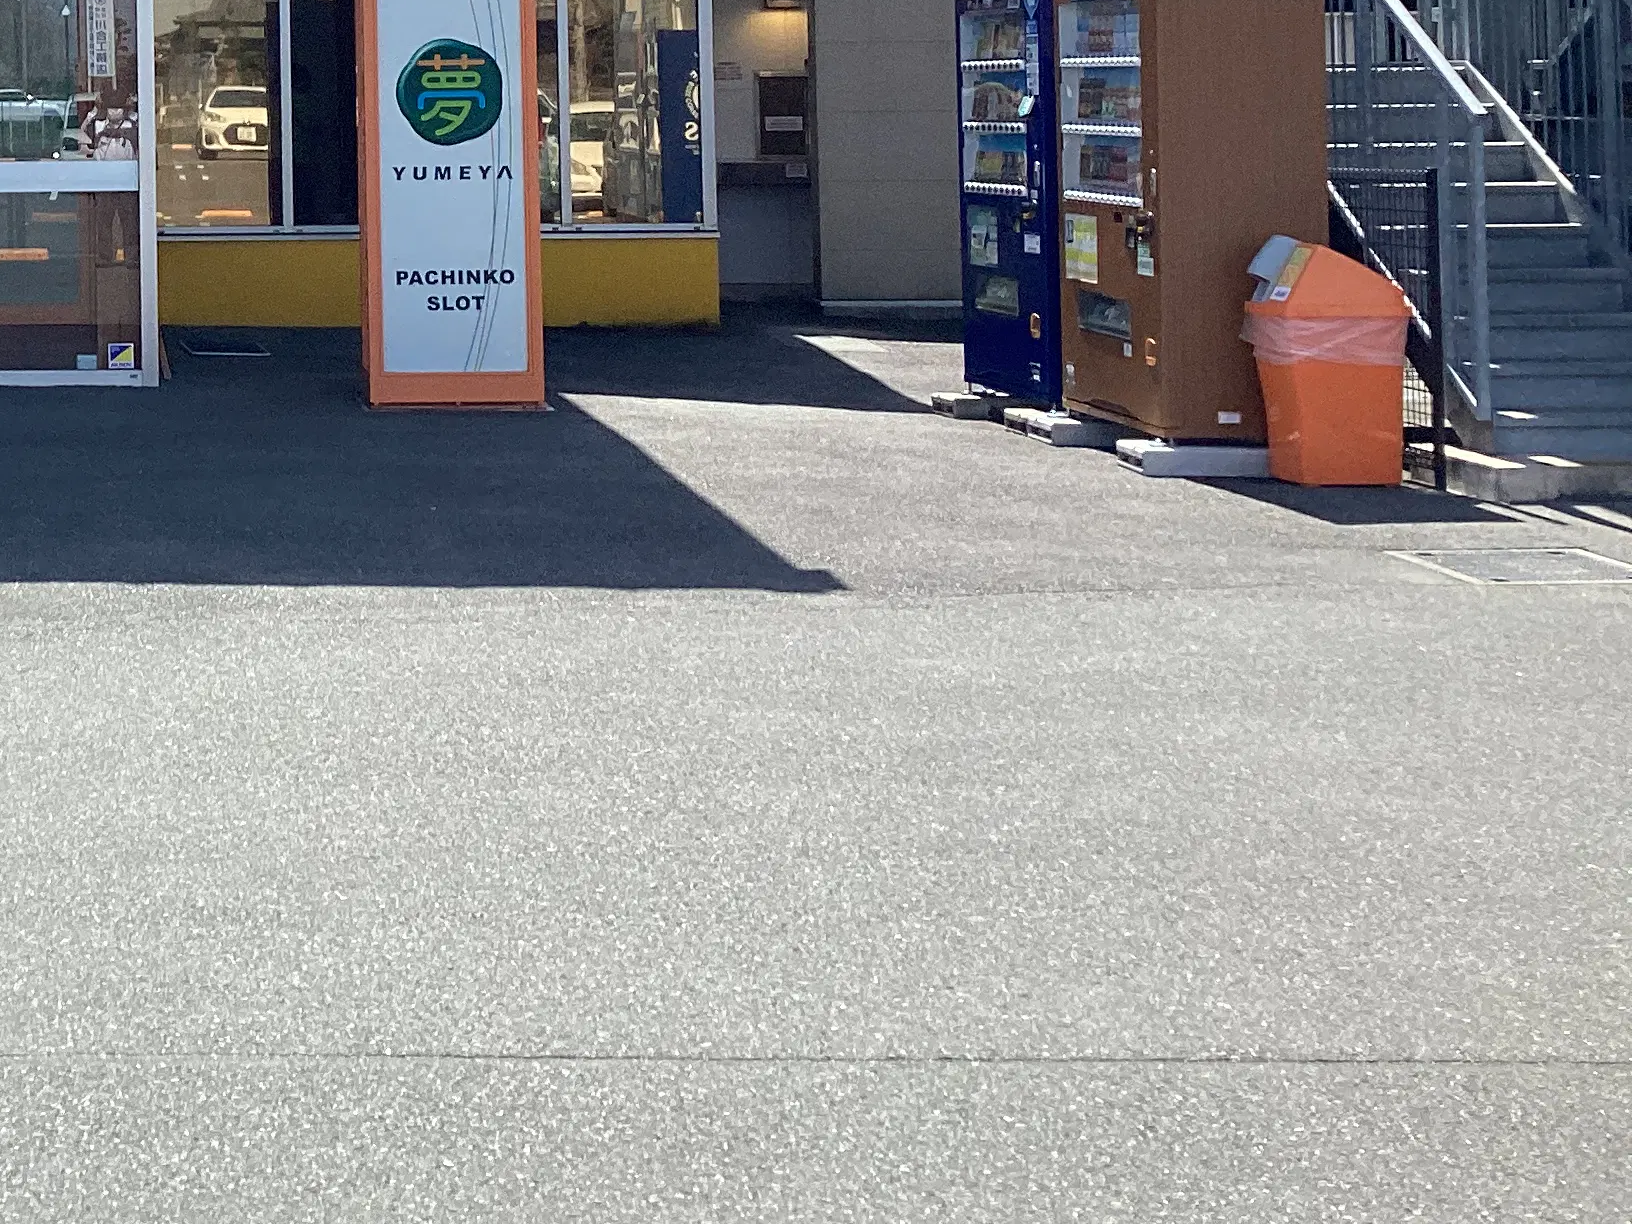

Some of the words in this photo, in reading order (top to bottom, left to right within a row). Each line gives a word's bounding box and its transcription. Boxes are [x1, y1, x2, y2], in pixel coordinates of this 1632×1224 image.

[416, 53, 486, 136] 夢
[392, 165, 514, 181] YUMEYA
[395, 269, 516, 286] PACHINKO
[426, 295, 486, 312] SLOT
